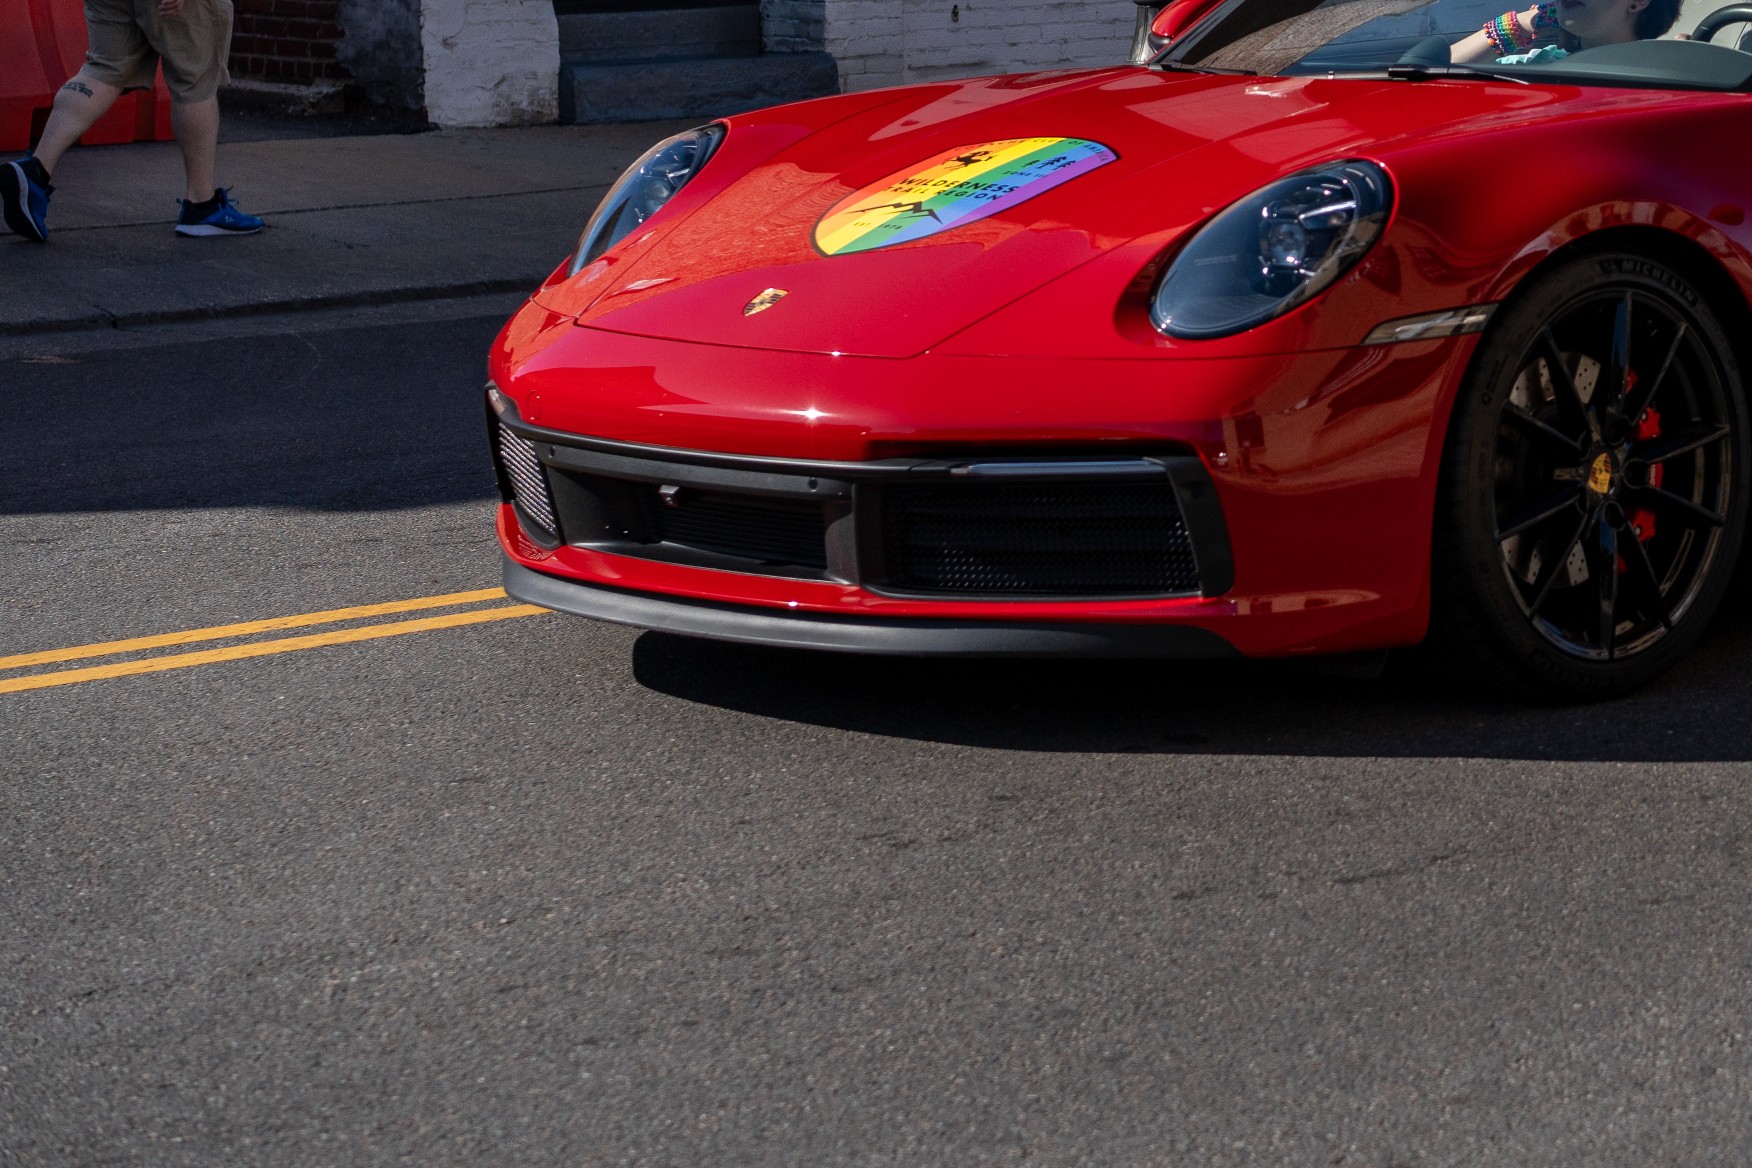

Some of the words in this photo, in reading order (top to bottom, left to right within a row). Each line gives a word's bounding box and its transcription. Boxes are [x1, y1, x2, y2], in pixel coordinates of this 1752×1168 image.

[899, 177, 1020, 193] WILDERNESS
[883, 186, 929, 194] TRAIL
[934, 188, 1002, 201] REGION
[1621, 258, 1697, 306] MICHELIN
